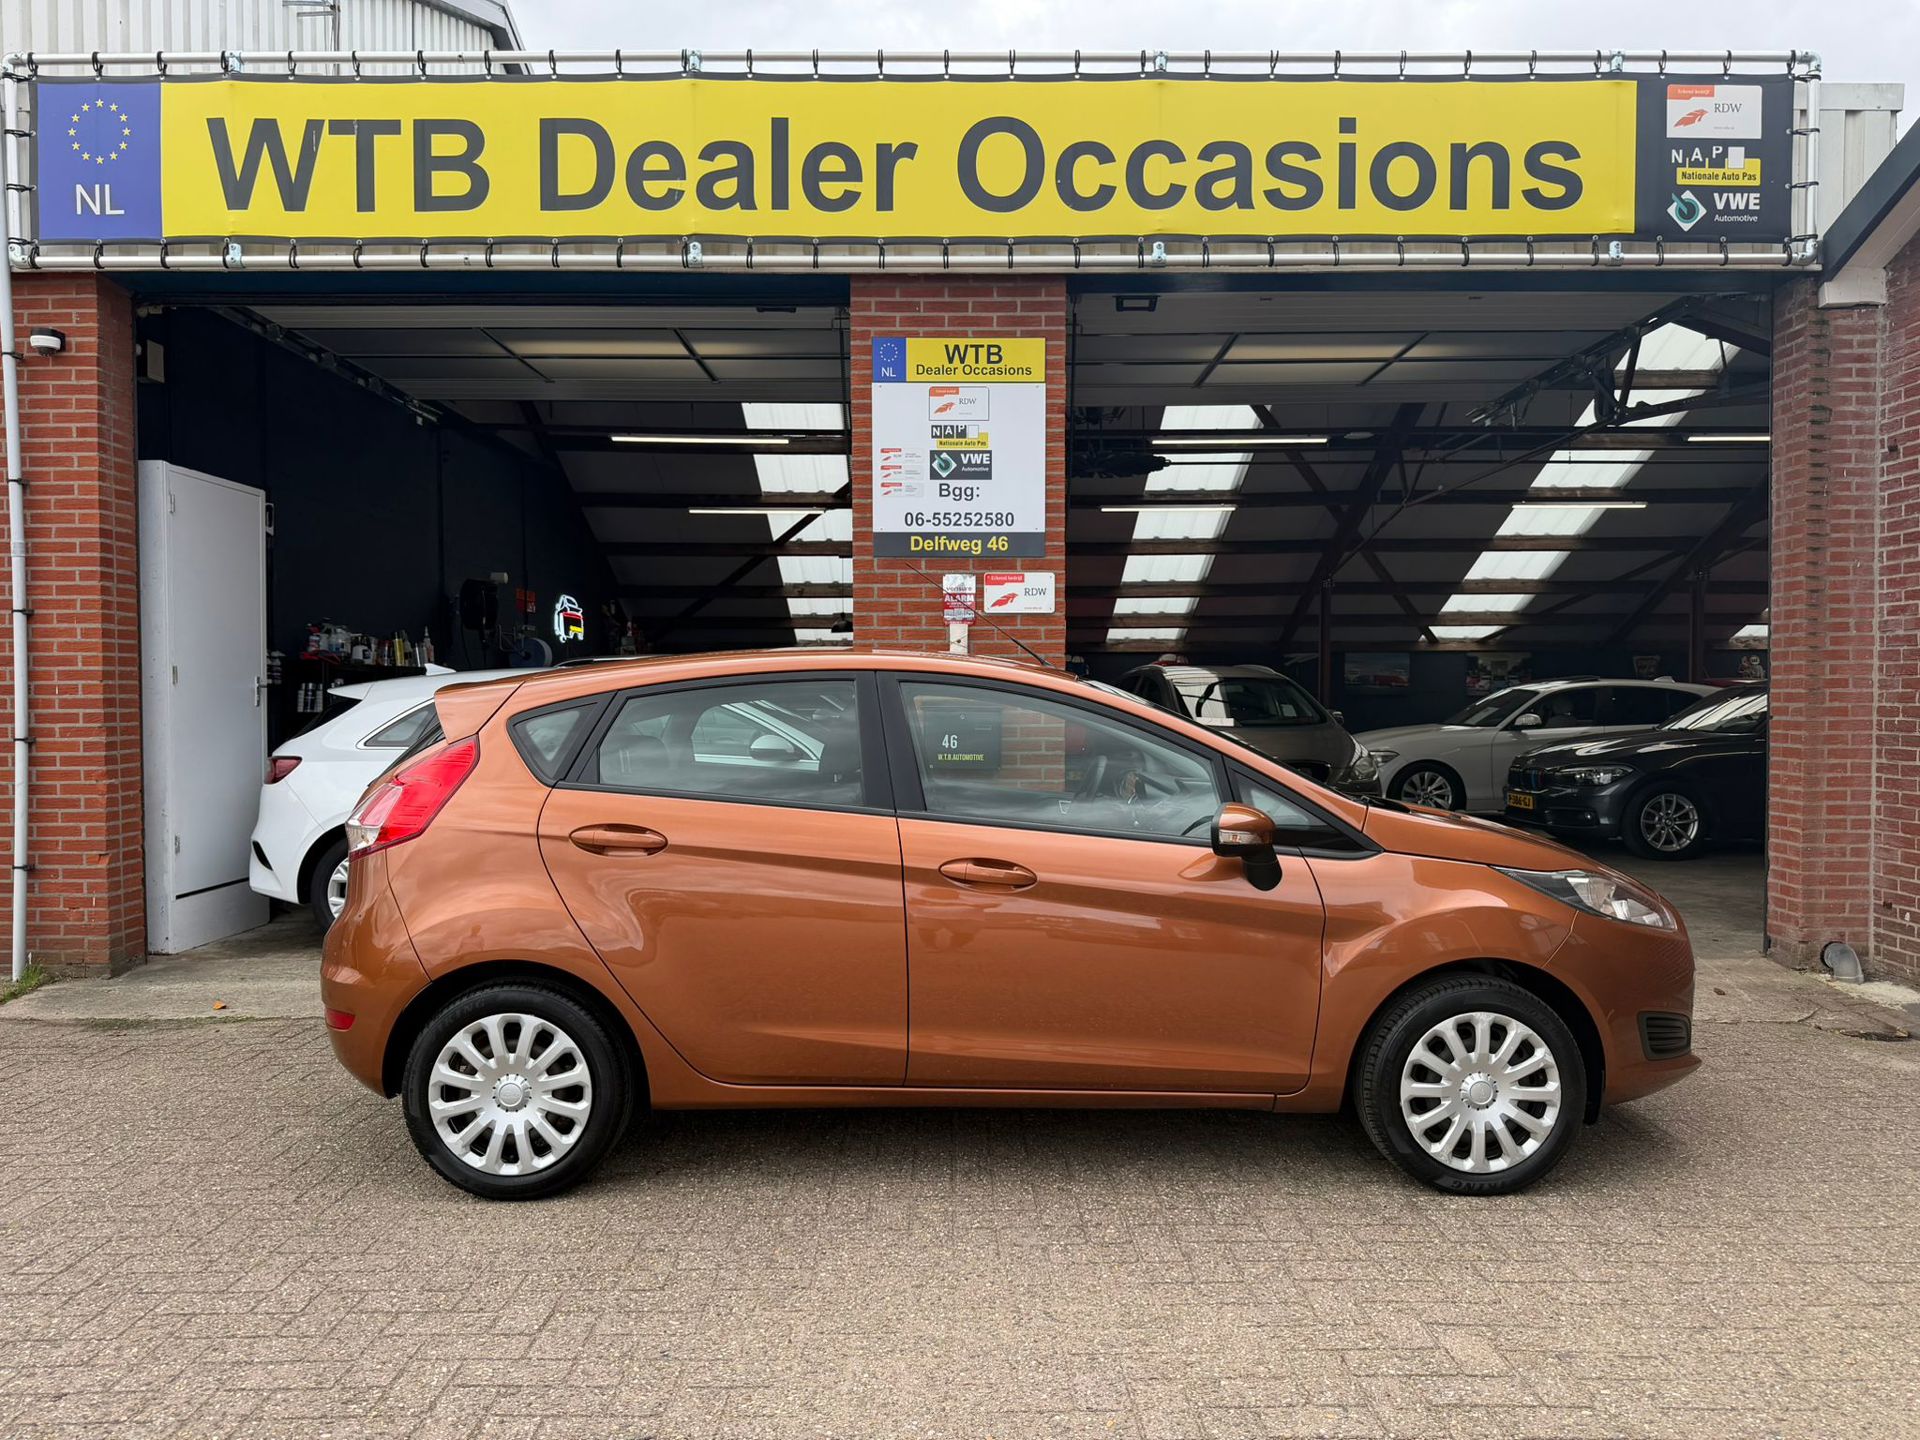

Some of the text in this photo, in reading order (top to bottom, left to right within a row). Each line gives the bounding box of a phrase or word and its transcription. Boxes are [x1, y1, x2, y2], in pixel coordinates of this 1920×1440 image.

[1714, 103, 1742, 113] RDW
[206, 115, 1584, 213] WTB Dealer Occasions
[1681, 171, 1757, 181] Nationale Auto Pas
[75, 184, 125, 215] NL
[1713, 192, 1760, 210] VWE
[1714, 214, 1758, 222] Automotive
[944, 344, 1004, 364] WTB
[881, 367, 897, 377] NL
[916, 364, 1032, 376] Dealer Occasions
[960, 453, 990, 464] VWE
[938, 483, 981, 501] Bgg:
[904, 511, 1015, 527] 06-55252580
[910, 535, 1009, 554] Delfweg 46
[1024, 587, 1047, 596] RDW
[942, 734, 958, 749] 46
